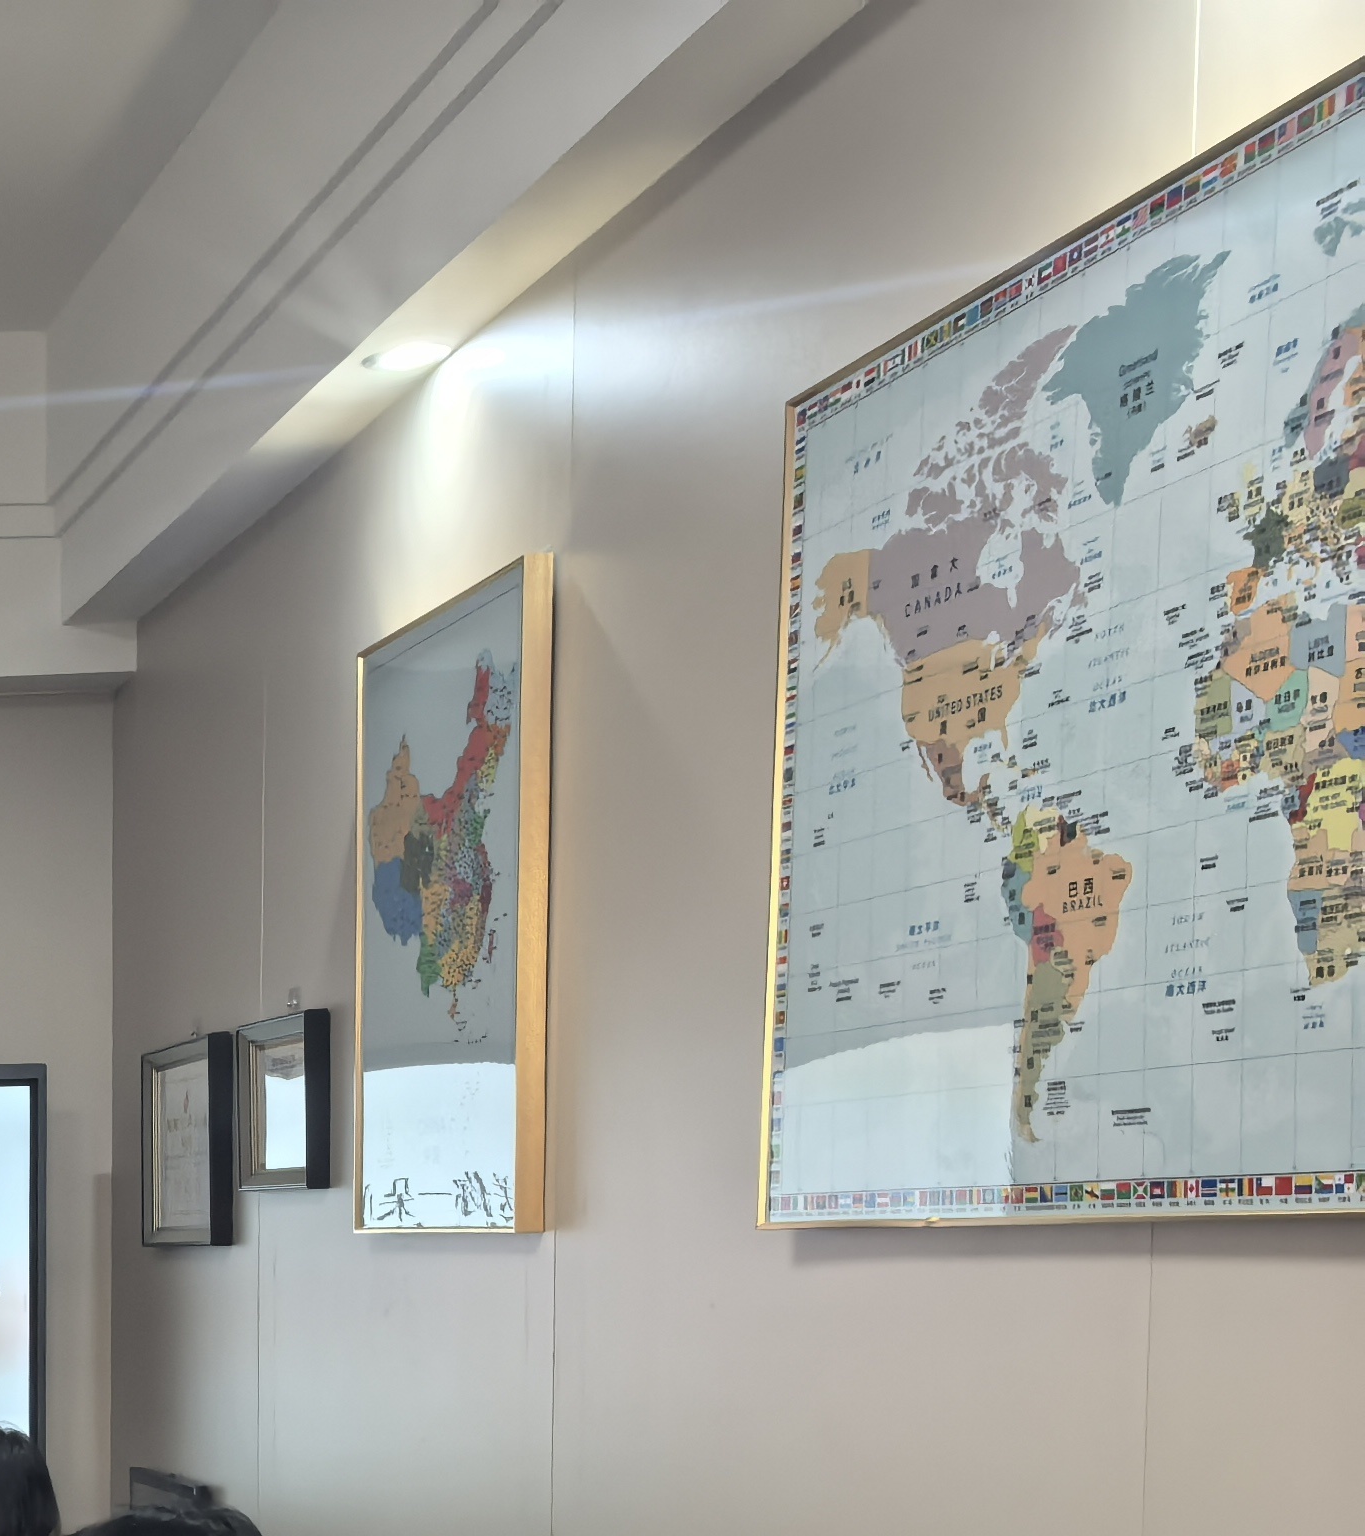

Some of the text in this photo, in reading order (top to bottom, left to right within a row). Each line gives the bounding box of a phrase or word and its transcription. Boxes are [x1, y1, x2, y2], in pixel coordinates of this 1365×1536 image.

[904, 582, 963, 618] CANADA
[927, 685, 1004, 722] UNITED STATES
[1062, 895, 1103, 914] BRAZIL
